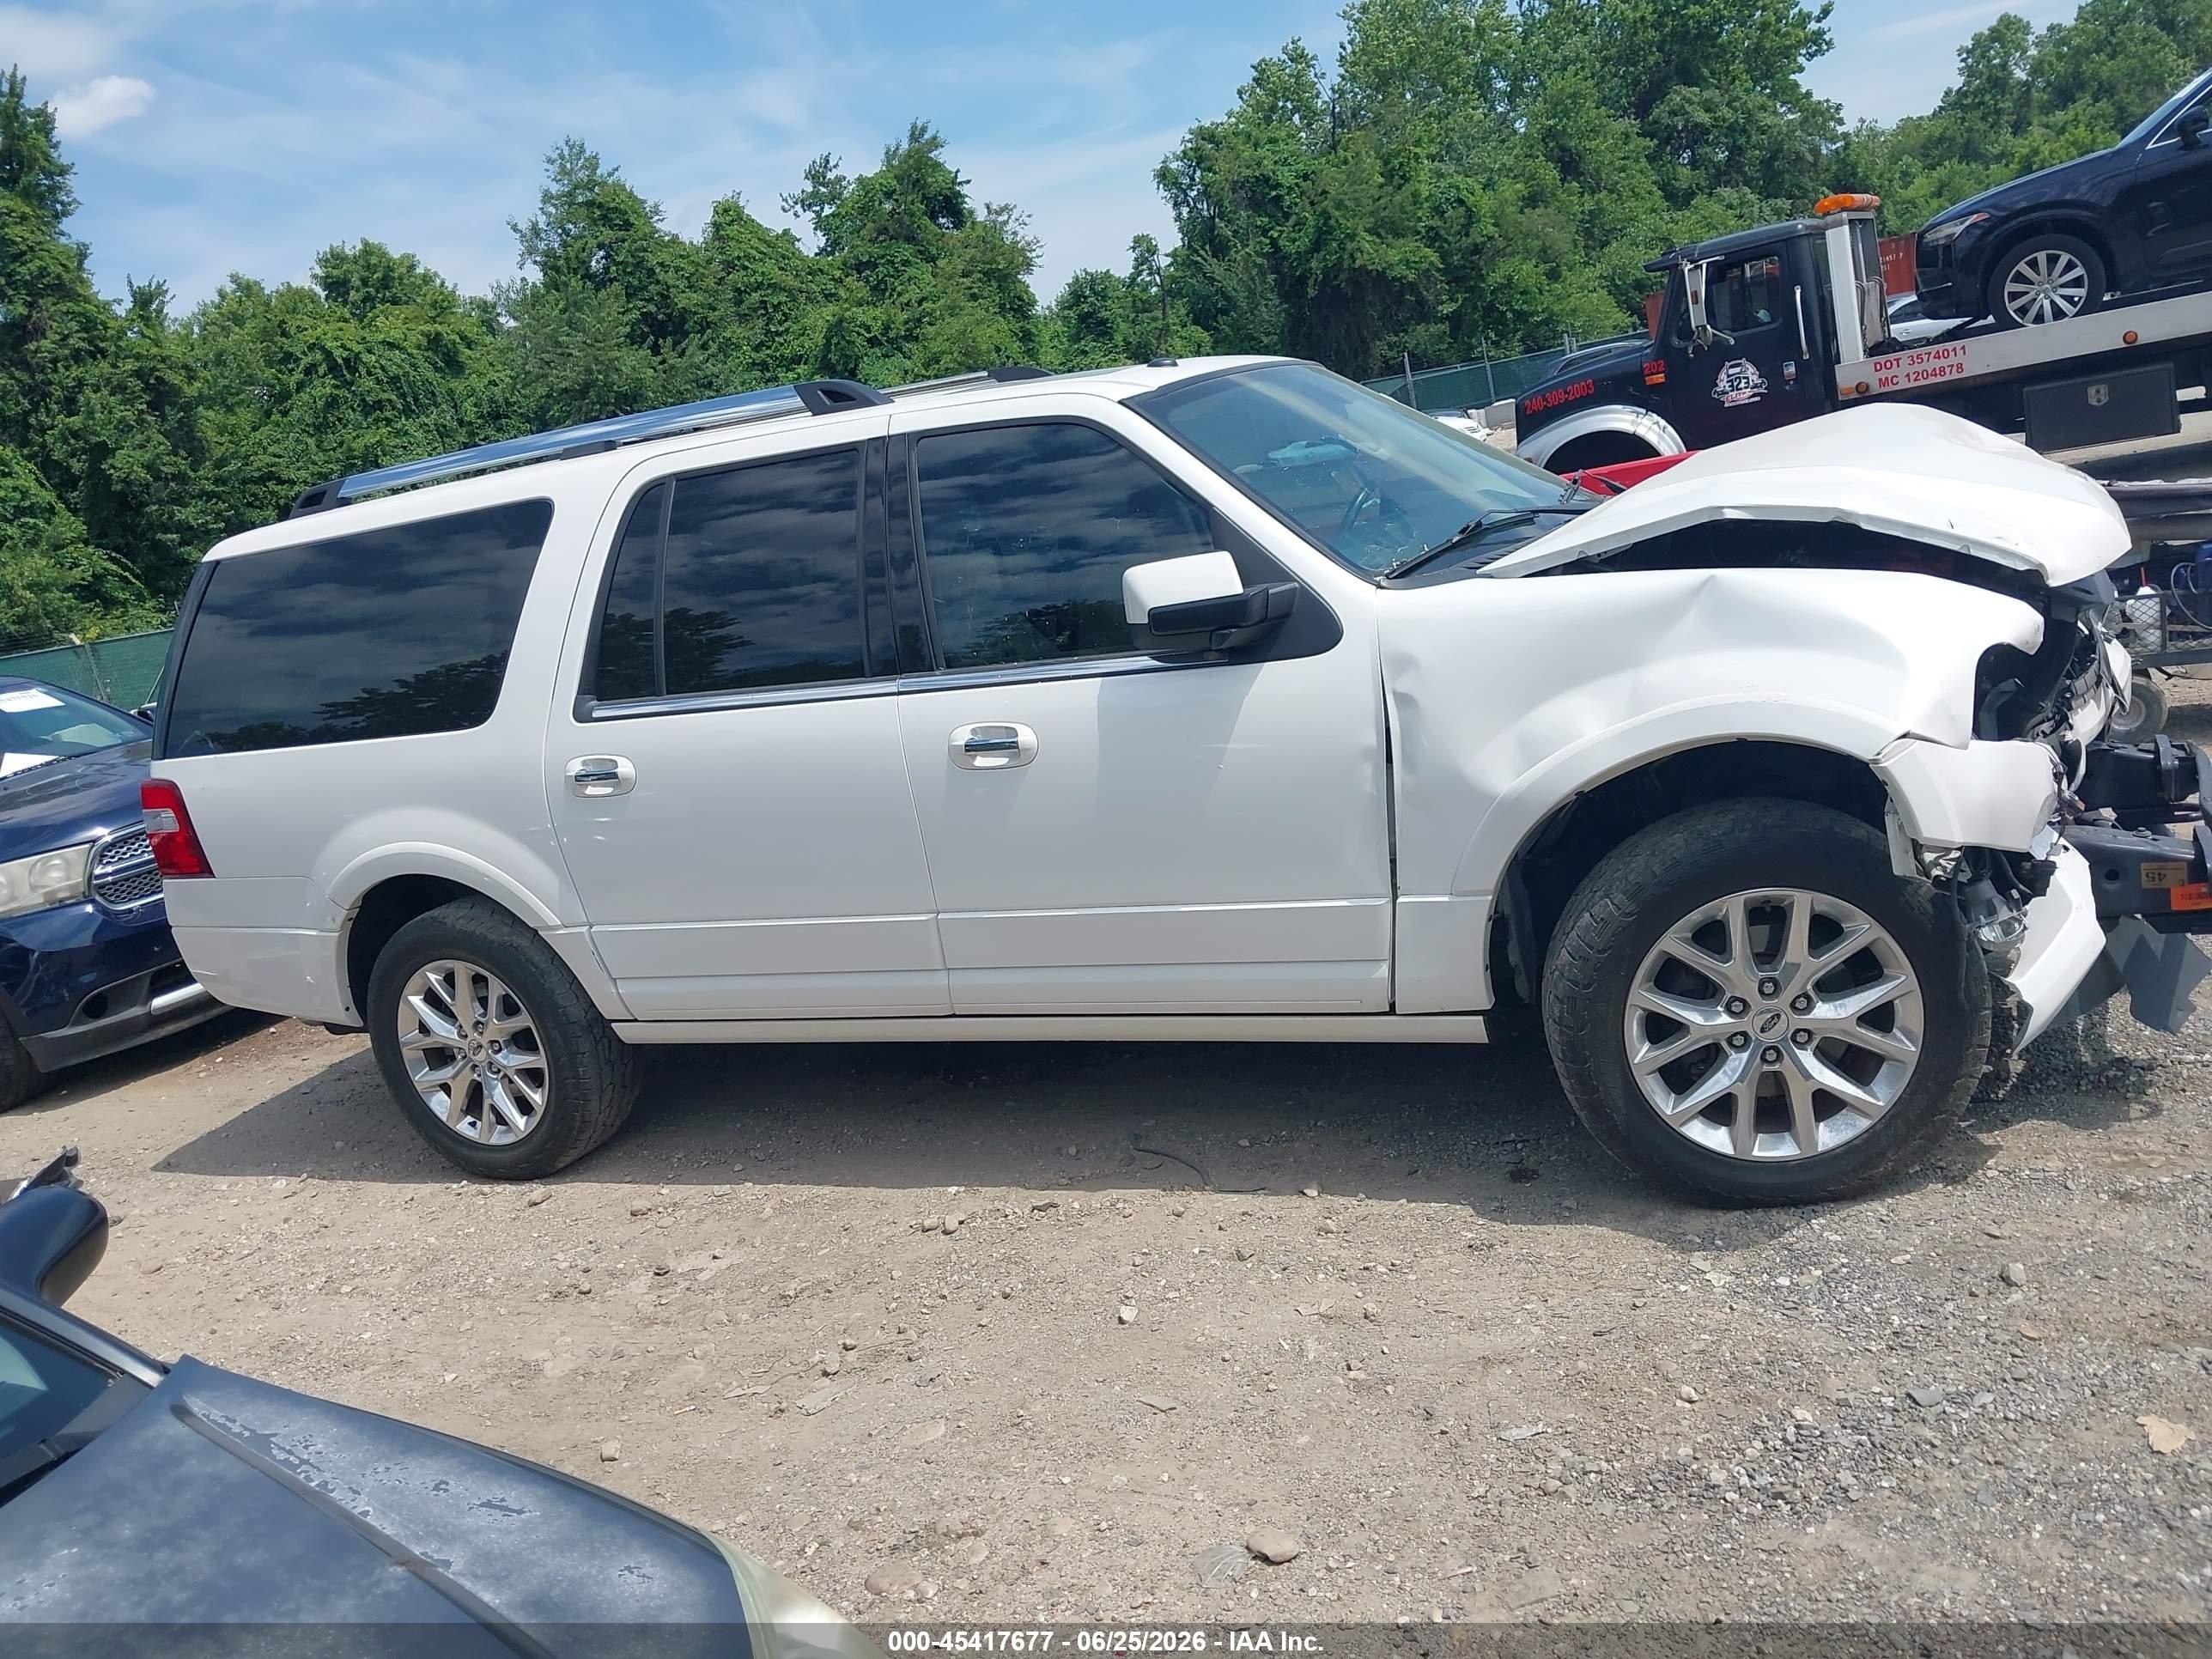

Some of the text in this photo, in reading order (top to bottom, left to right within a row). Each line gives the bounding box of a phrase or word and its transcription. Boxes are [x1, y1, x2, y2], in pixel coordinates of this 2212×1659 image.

[1874, 344, 1967, 373] DOT 3574011
[1644, 360, 1666, 374] 202
[1878, 362, 1965, 389] MC 1204878
[1726, 376, 1750, 392] 323
[1524, 379, 1595, 416] 240-309-2003
[2145, 871, 2167, 883] 45
[1763, 1015, 1779, 1031] Ford
